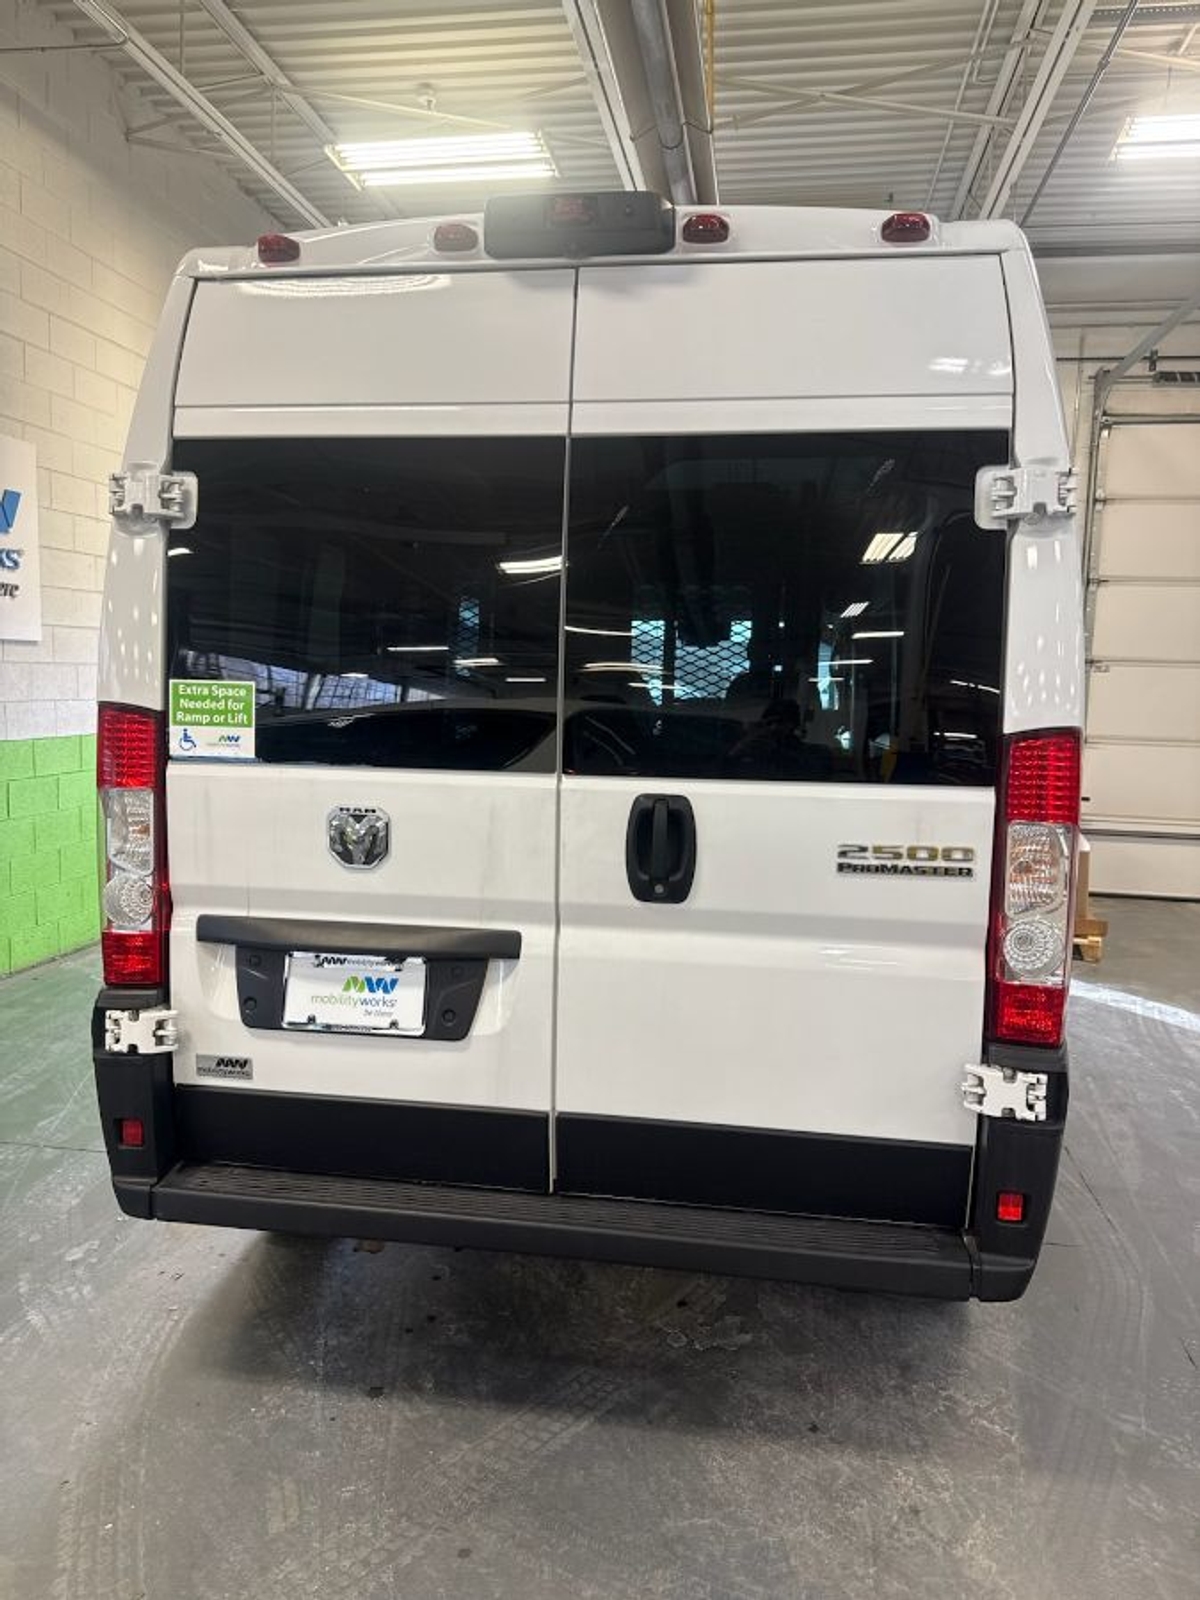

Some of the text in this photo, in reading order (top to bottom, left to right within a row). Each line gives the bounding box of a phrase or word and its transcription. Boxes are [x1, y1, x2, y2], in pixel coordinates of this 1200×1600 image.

[178, 684, 246, 697] Extra Space
[179, 698, 245, 710] Needed for
[176, 711, 248, 724] Ramp or Lift
[837, 844, 974, 862] 2500
